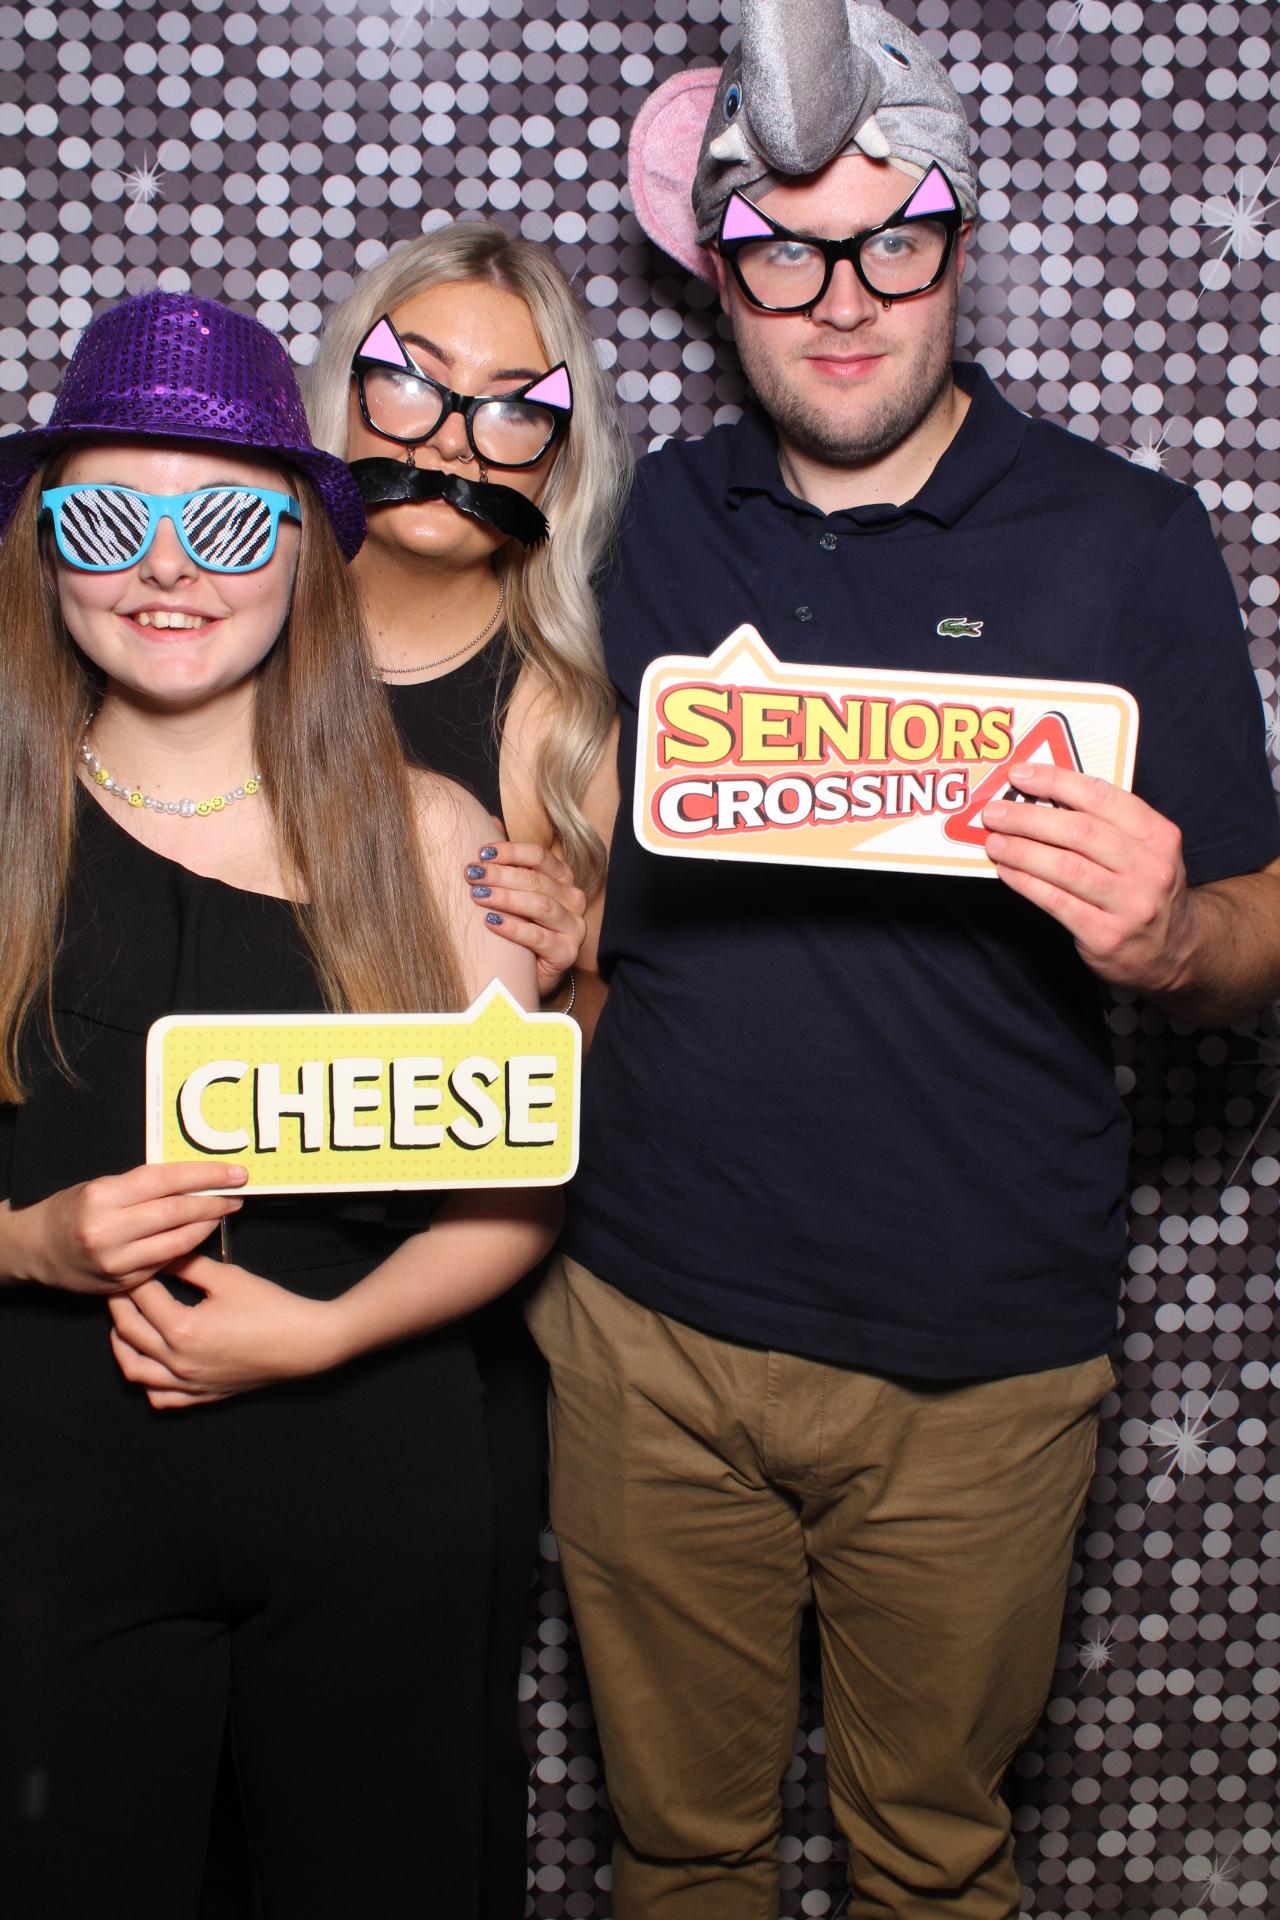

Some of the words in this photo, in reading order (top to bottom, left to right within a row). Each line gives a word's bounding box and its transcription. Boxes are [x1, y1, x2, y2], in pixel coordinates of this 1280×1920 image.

[662, 686, 1012, 764] SENIORS
[657, 772, 967, 834] CROSSING
[176, 1055, 559, 1154] CHEESE
